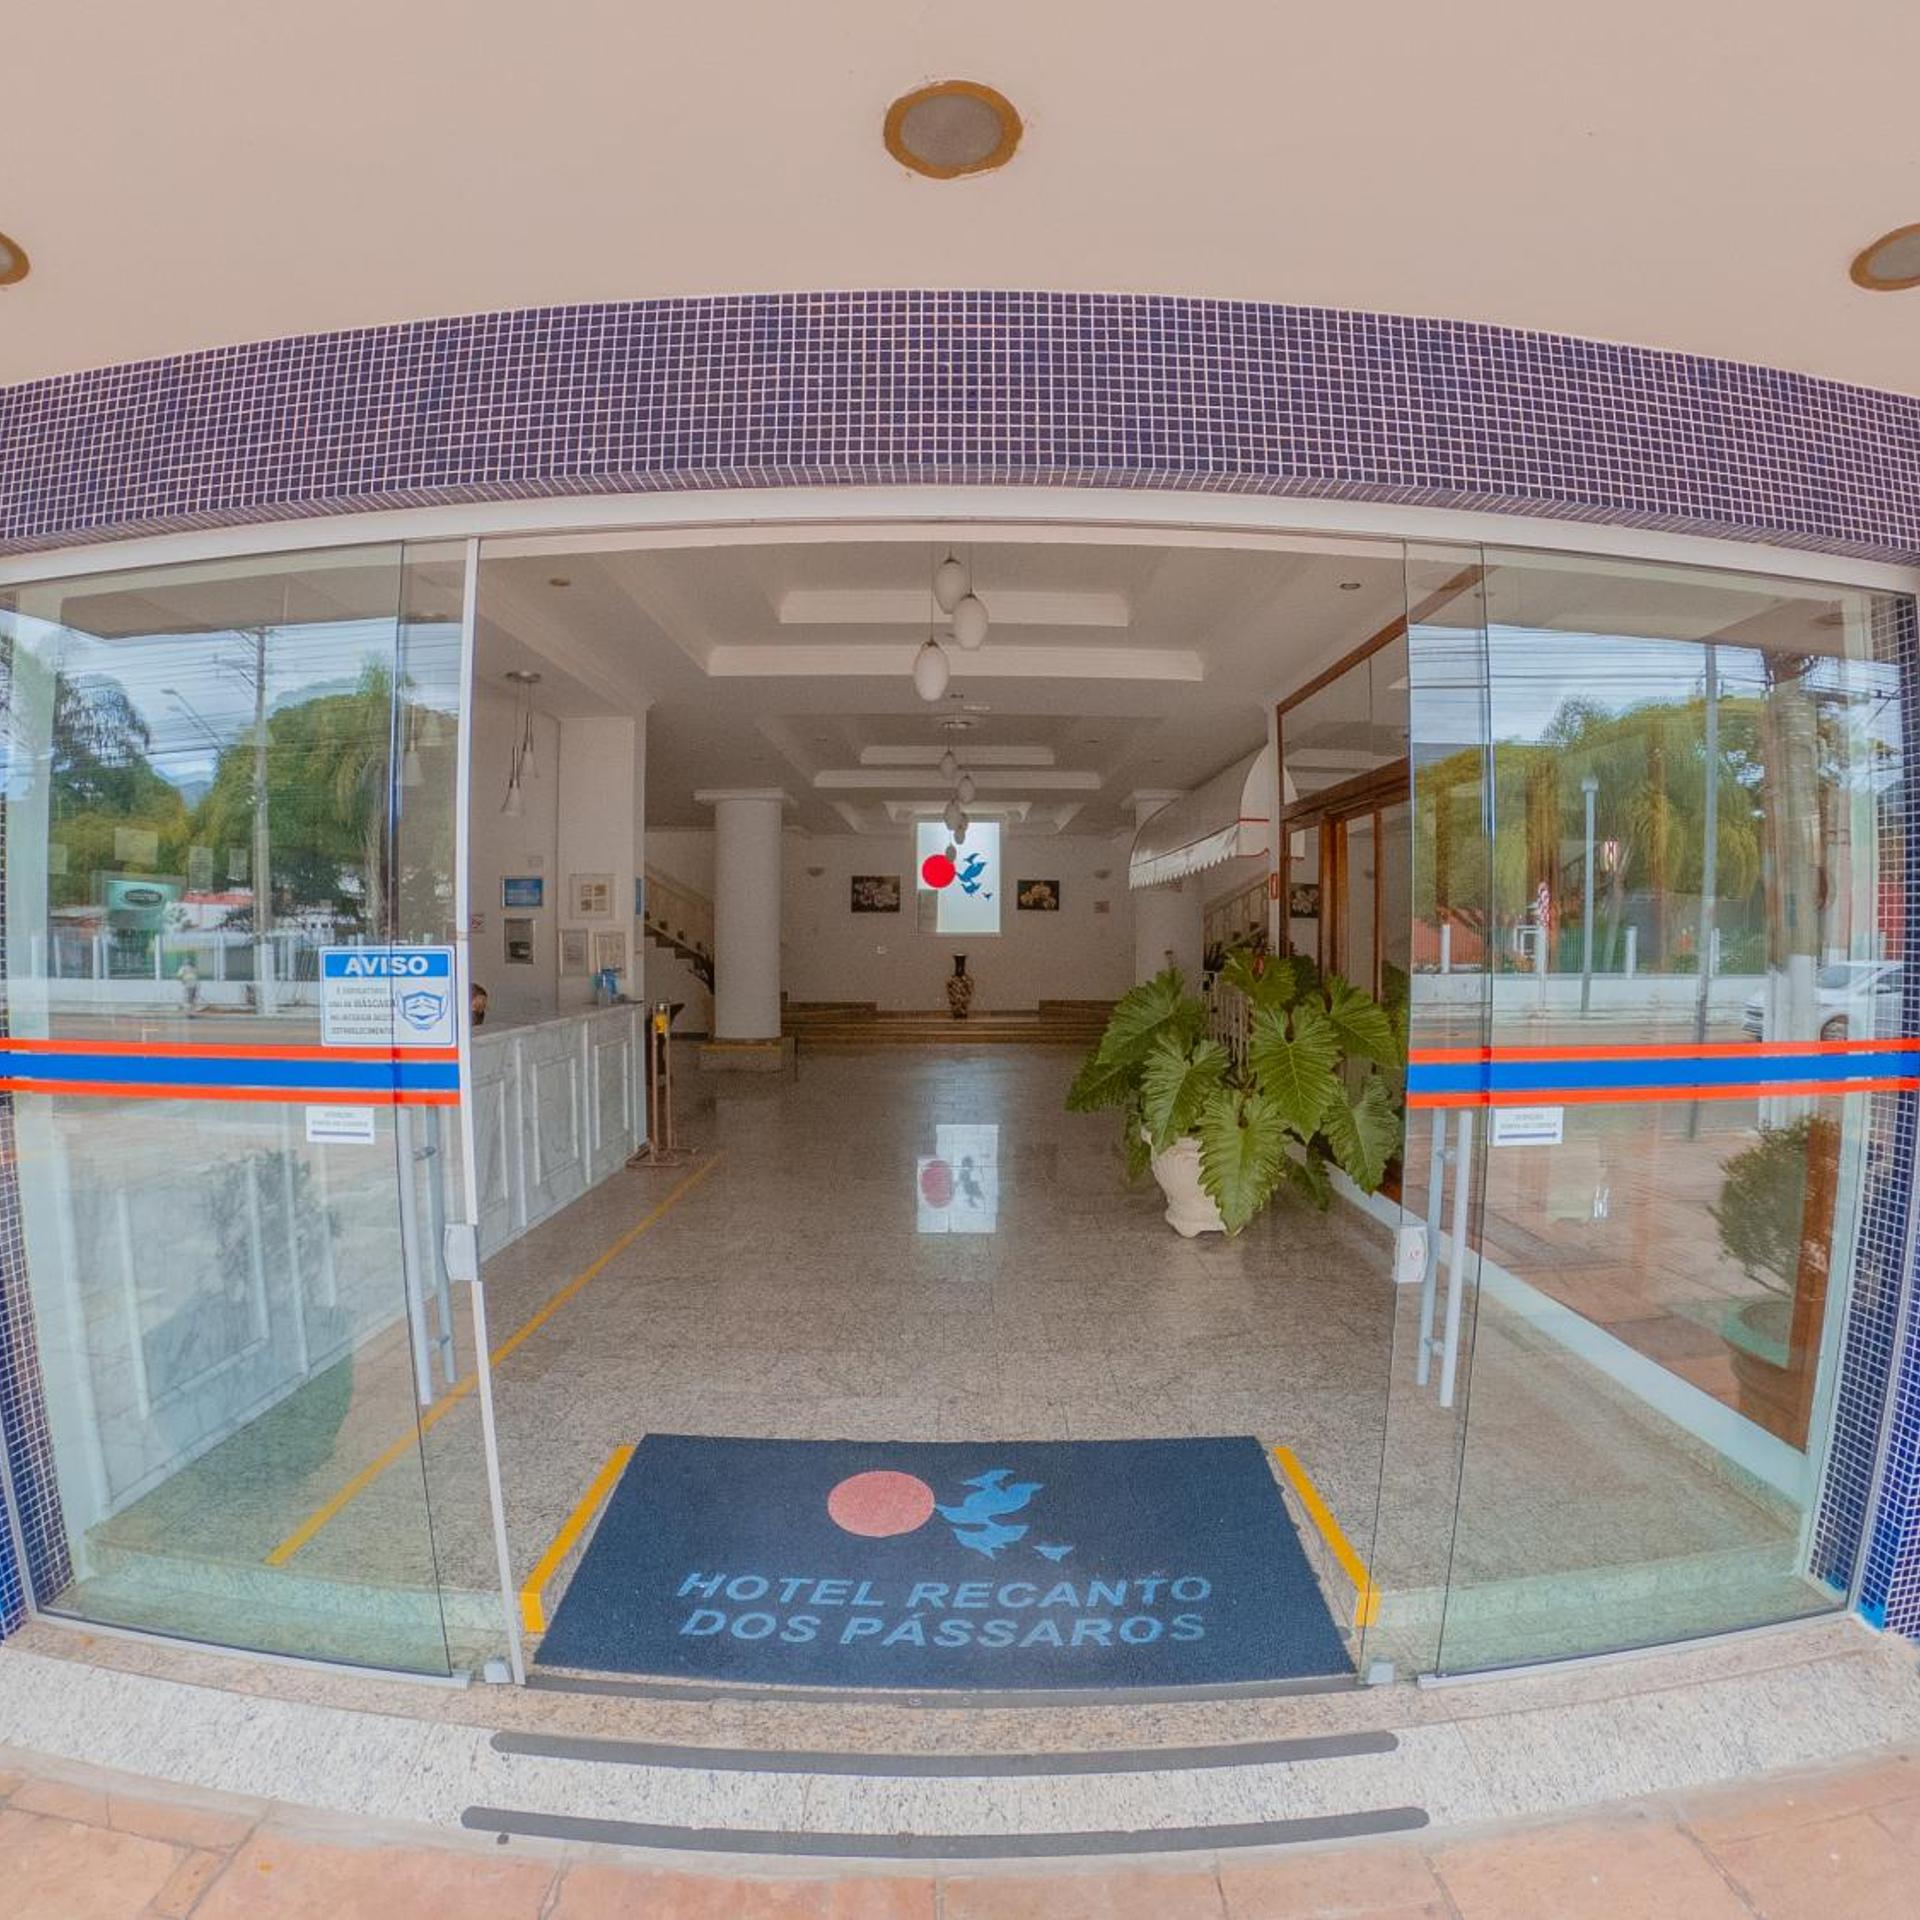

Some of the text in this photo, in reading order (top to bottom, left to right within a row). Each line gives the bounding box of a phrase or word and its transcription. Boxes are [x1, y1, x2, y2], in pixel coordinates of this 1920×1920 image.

[345, 957, 429, 975] AVISO
[677, 1573, 1212, 1608] HOTEL RECANTO
[680, 1610, 1206, 1648] DOS PÁSSAROS
